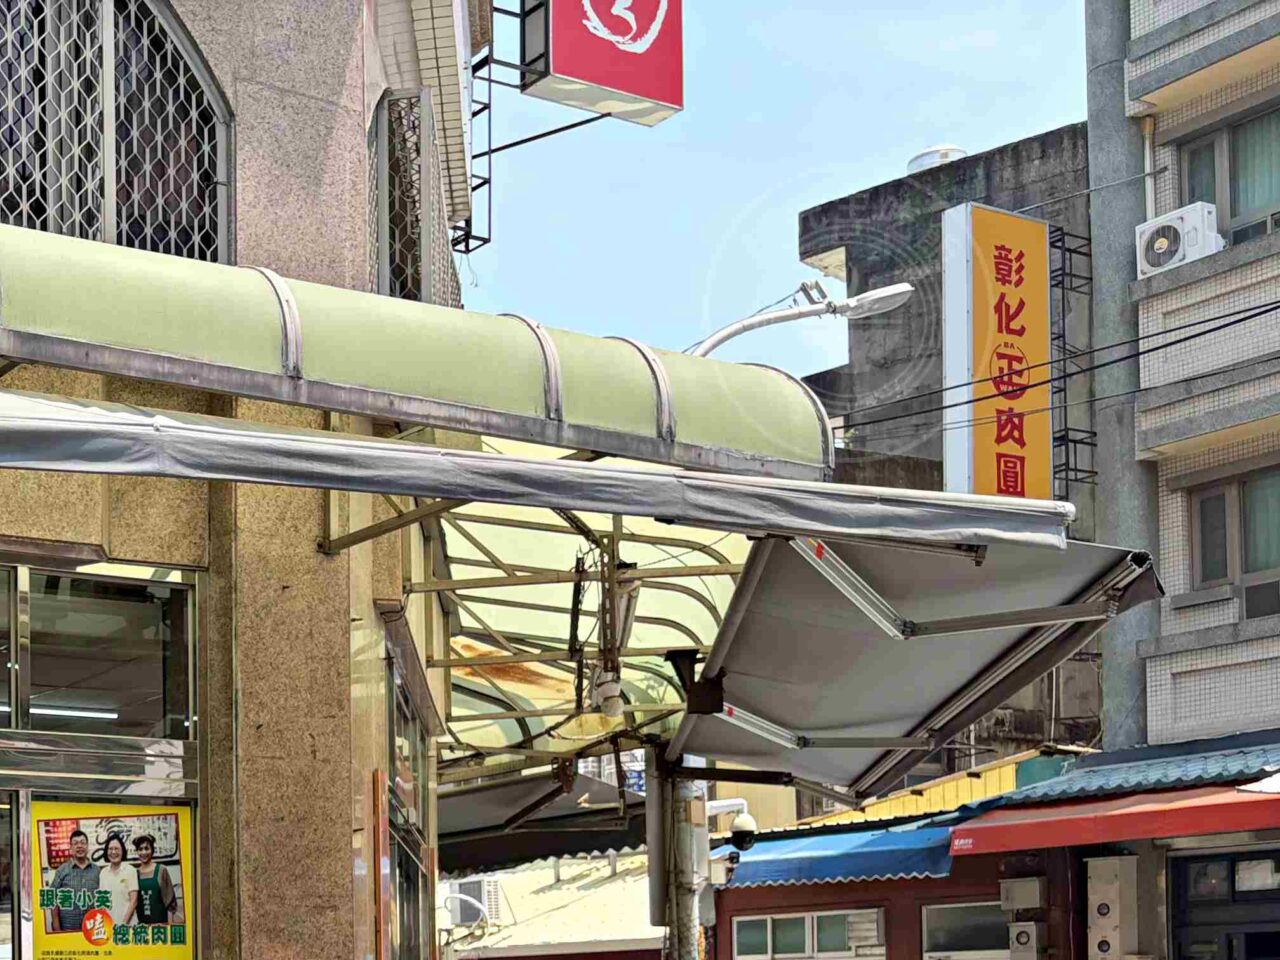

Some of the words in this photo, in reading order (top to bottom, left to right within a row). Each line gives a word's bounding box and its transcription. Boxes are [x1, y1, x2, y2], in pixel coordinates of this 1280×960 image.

[990, 243, 1030, 498] 彰化正肉圓
[39, 889, 112, 909] 跟著小英
